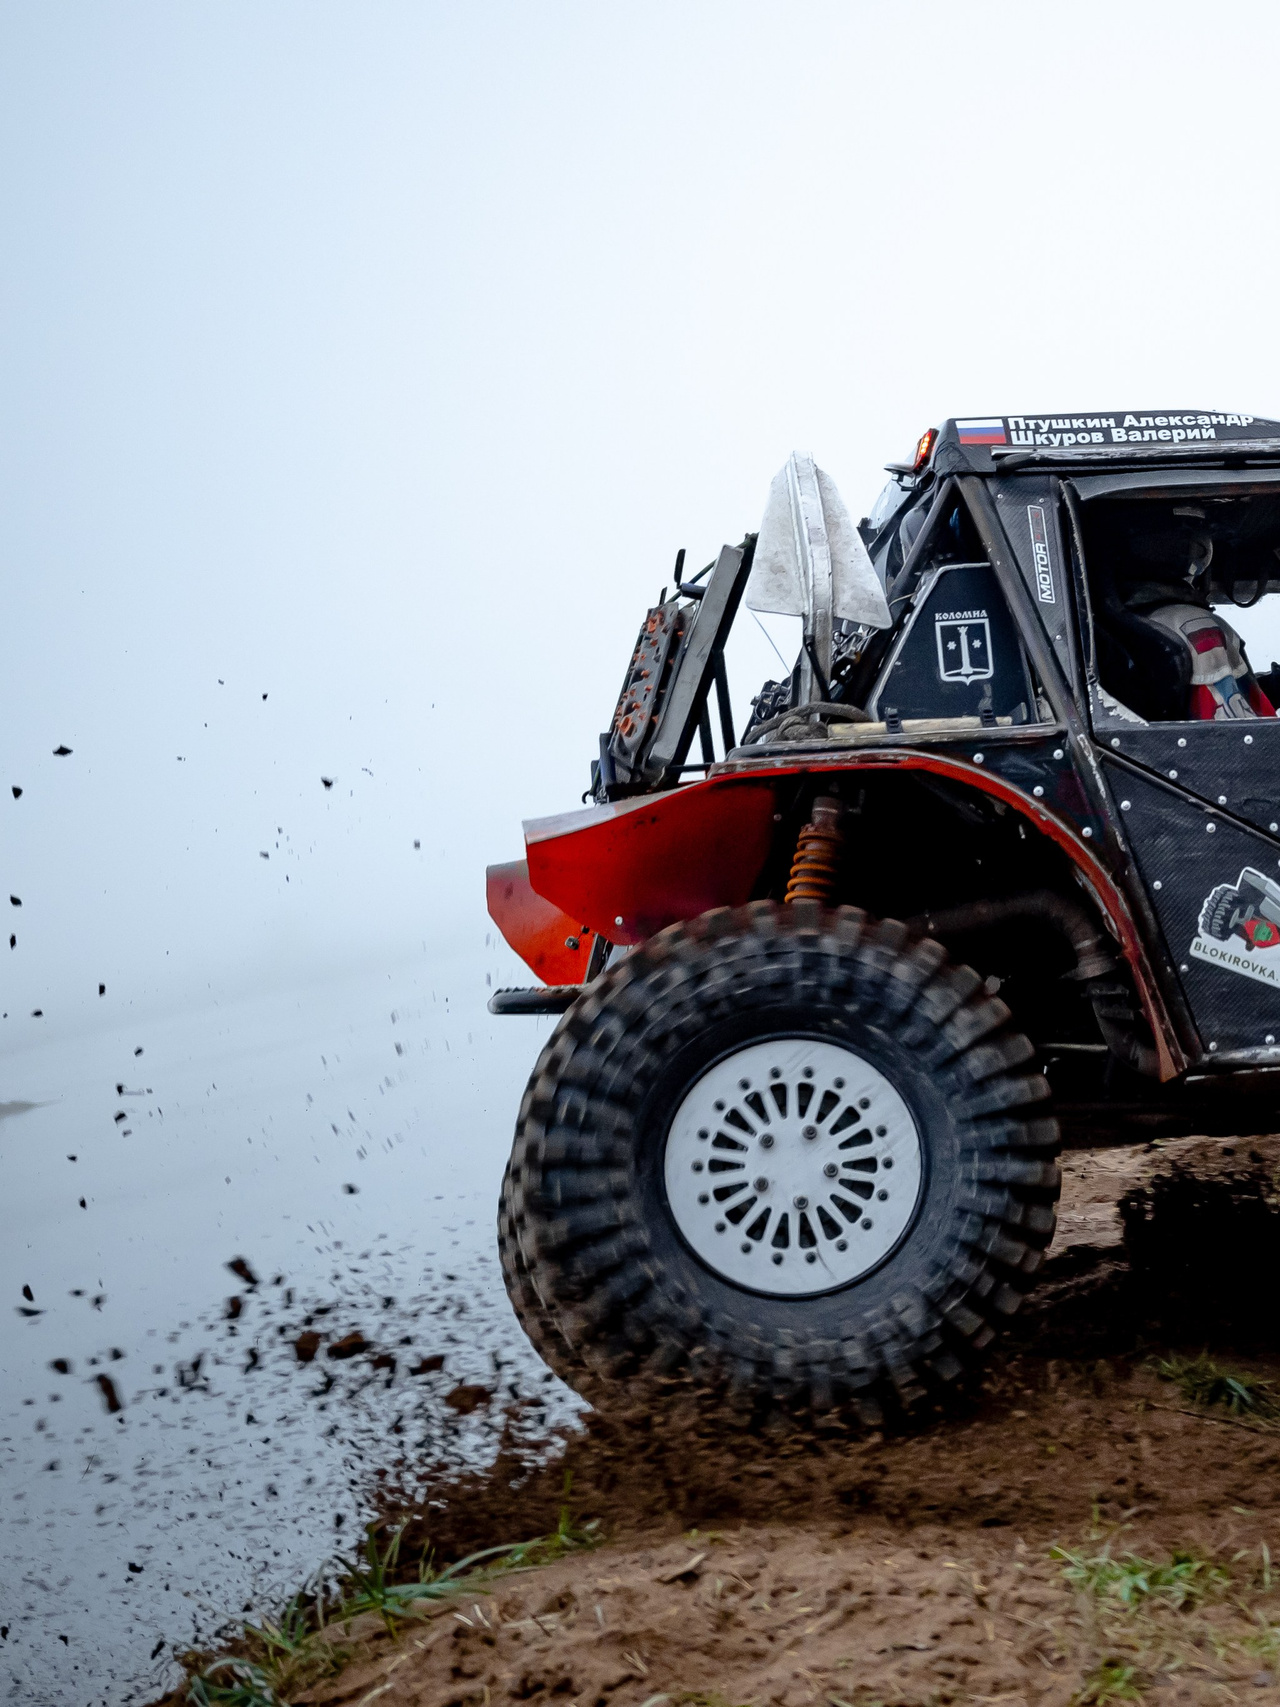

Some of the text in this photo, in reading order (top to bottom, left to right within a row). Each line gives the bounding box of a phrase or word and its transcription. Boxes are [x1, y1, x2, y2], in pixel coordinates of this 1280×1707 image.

[1007, 413, 1255, 432] Птушкин Александр
[1010, 424, 1216, 447] Шкуров Валерий
[1035, 543, 1053, 600] MOTOR
[934, 609, 988, 621] КОЛОМНА
